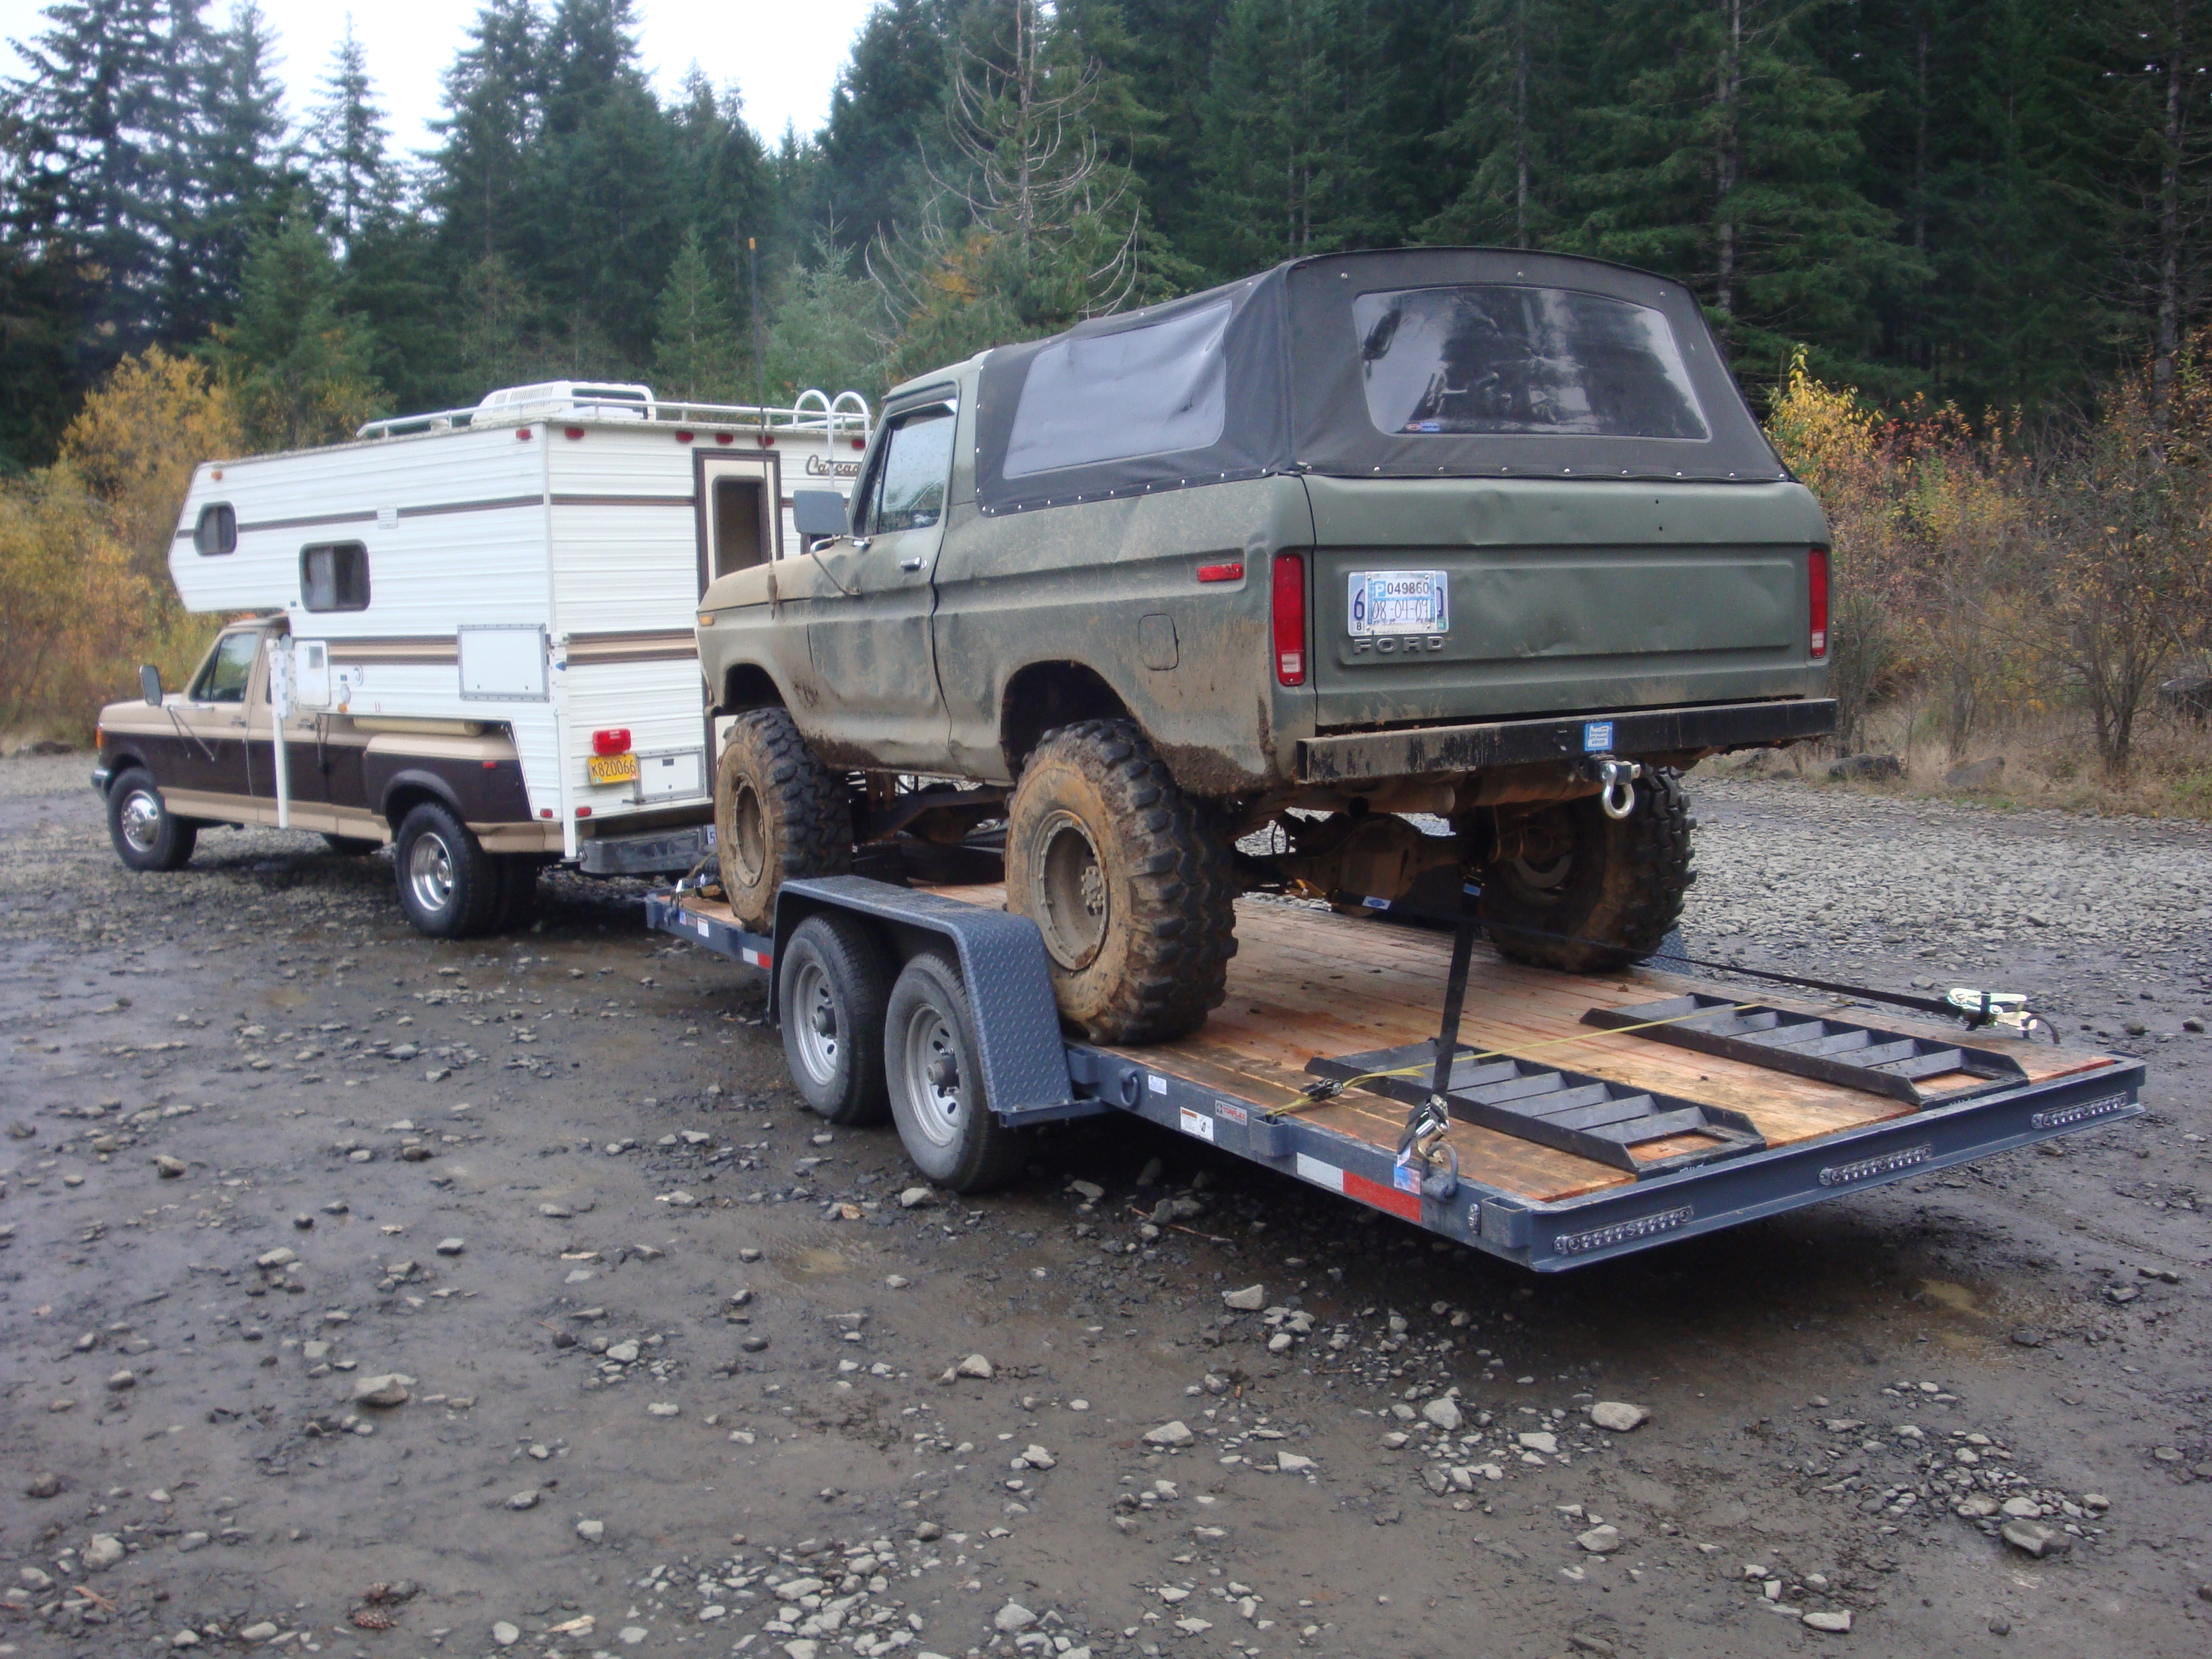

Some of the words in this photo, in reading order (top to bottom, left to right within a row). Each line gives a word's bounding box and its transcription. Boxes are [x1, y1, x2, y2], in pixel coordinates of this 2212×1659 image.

[1387, 582, 1429, 594] 049860
[1356, 622, 1362, 631] 8
[1353, 636, 1445, 655] FORD
[591, 760, 636, 777] K820066
